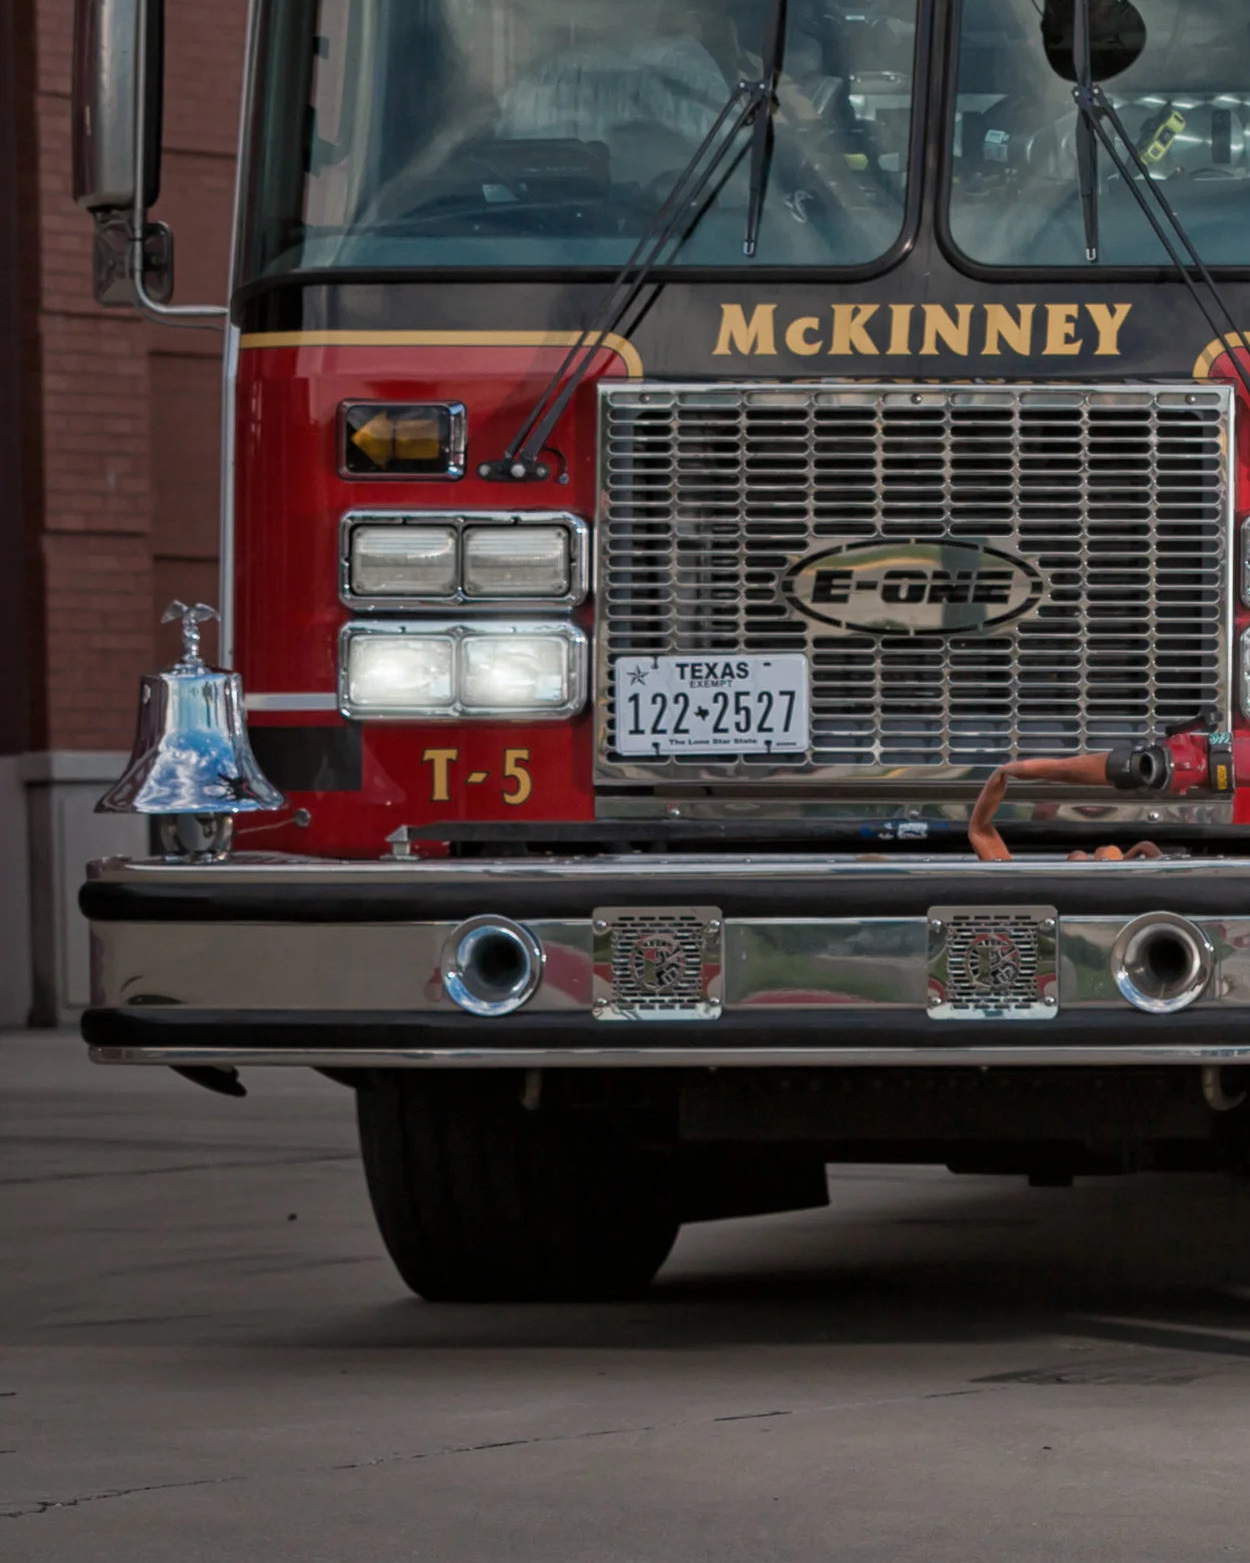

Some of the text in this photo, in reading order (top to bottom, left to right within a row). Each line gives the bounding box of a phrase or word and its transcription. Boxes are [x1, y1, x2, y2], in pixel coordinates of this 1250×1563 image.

[810, 569, 1014, 605] E-ONE
[676, 662, 749, 680] TEXAS
[689, 680, 733, 688] EXEMPT
